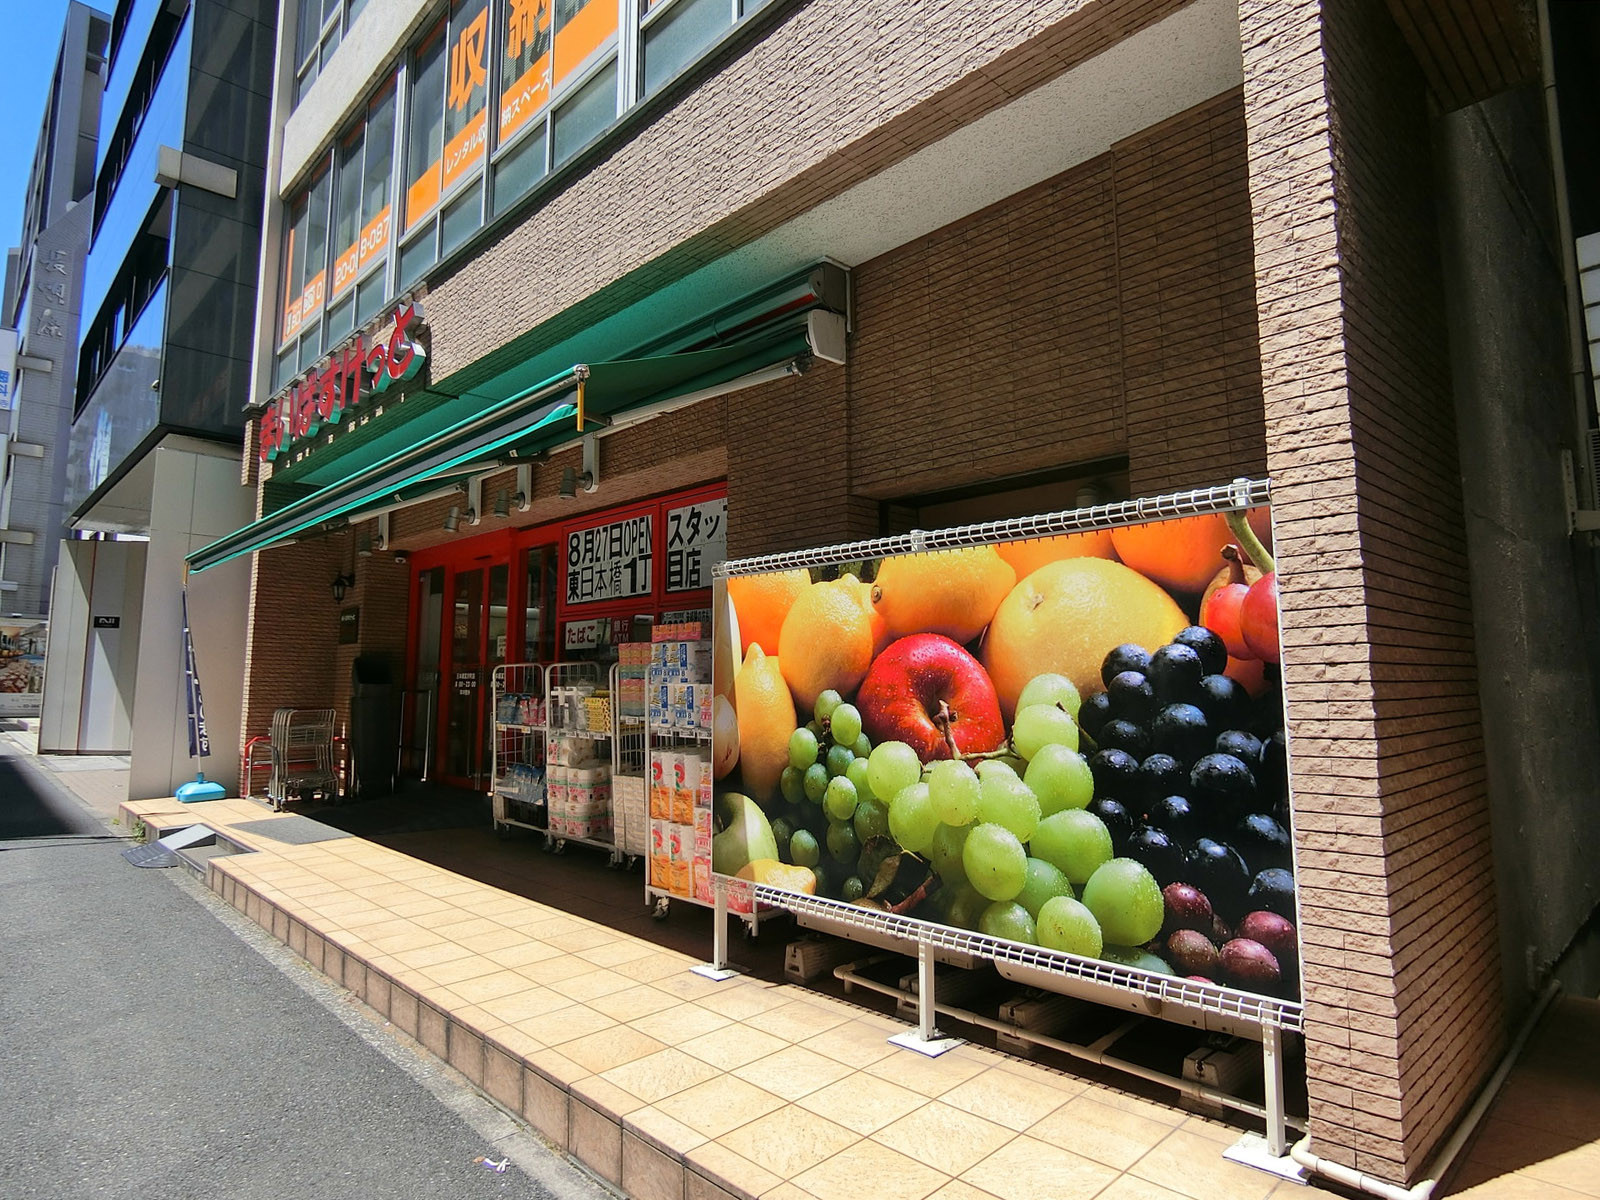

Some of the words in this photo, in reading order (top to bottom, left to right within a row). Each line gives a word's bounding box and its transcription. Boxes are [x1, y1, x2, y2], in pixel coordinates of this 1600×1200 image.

[259, 302, 426, 463] まいばすけっと
[669, 505, 728, 549] スタッ
[667, 549, 701, 588] 目店
[567, 626, 595, 644] たばこ
[613, 633, 629, 643] ATM
